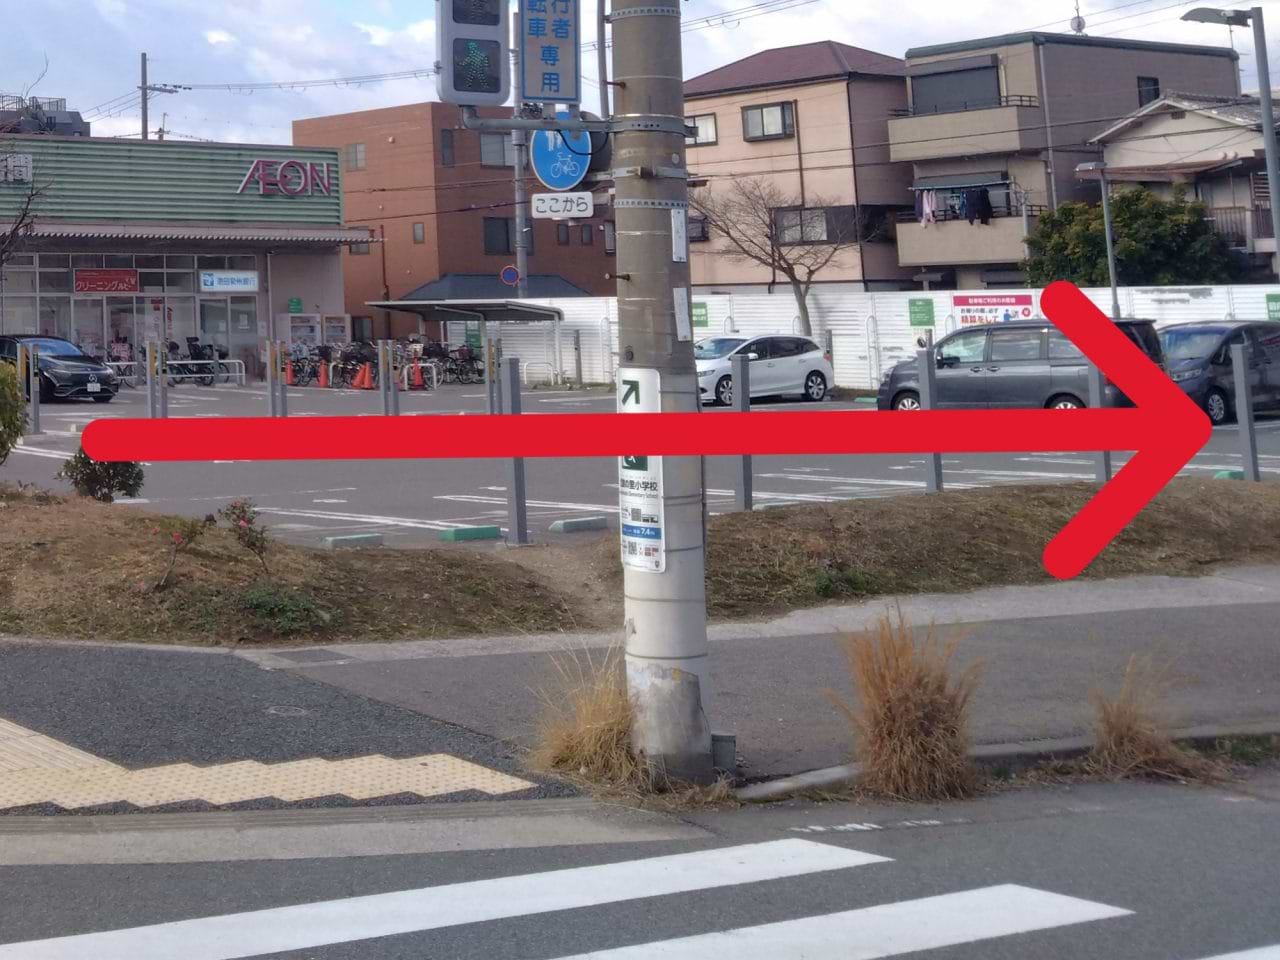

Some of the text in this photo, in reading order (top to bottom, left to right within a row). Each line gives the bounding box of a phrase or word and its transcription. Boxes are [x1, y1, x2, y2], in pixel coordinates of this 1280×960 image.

[540, 44, 560, 93] 専用
[536, 197, 589, 213] ここから
